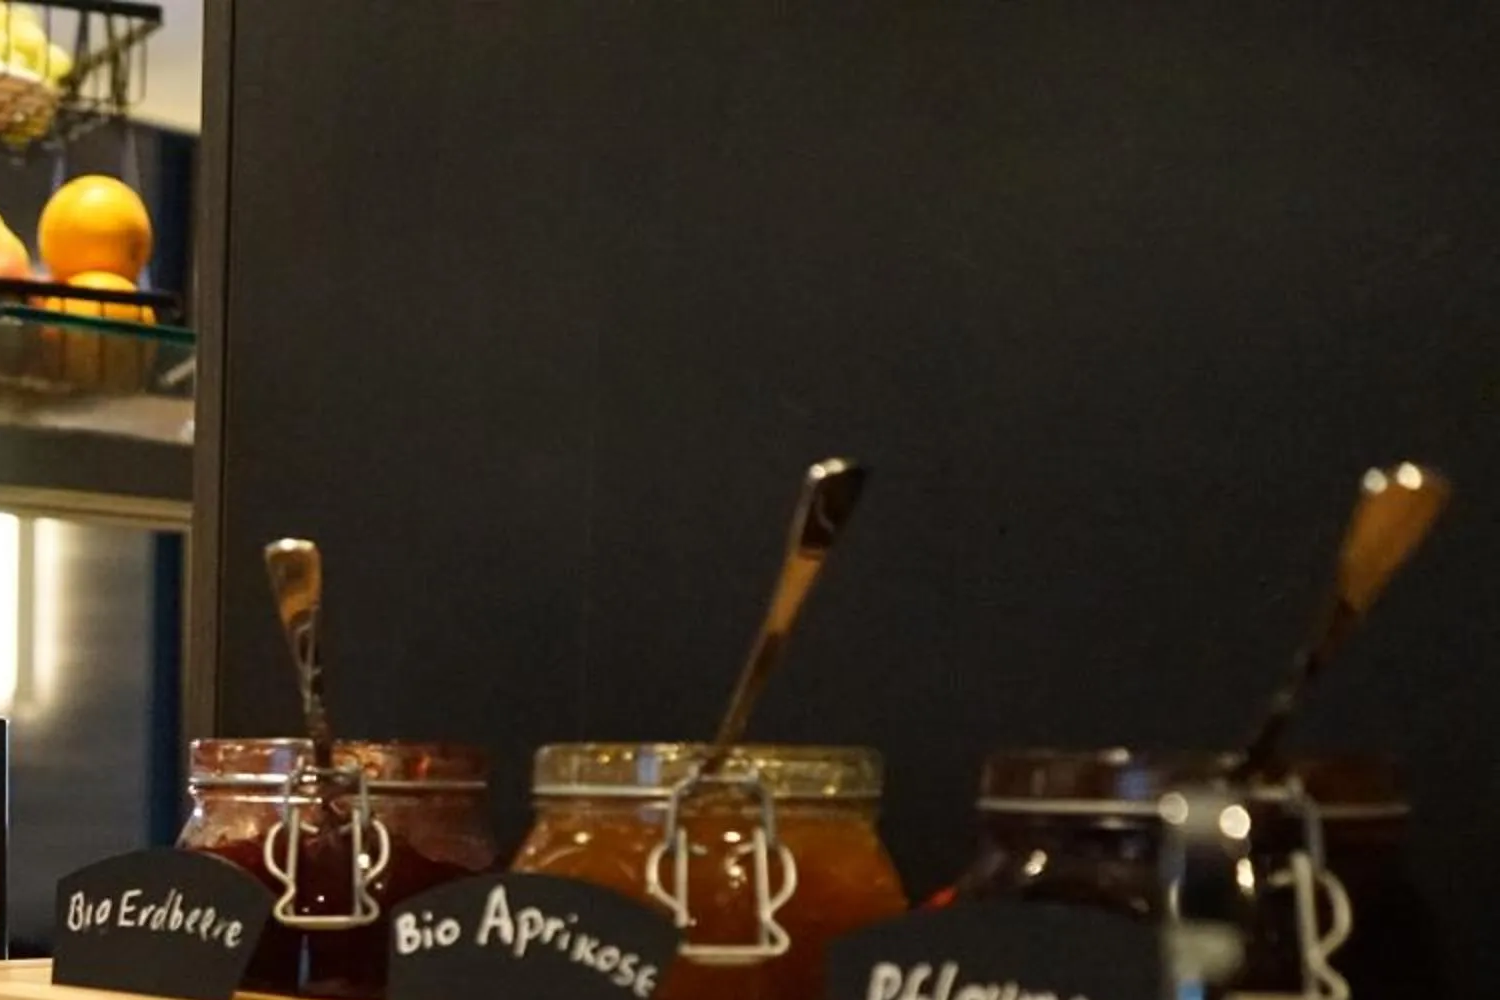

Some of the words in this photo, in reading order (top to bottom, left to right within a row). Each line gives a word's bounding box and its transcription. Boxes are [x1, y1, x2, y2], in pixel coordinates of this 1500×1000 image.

[67, 889, 112, 932] Bio
[117, 887, 243, 948] Erdbeere
[395, 910, 461, 954] Bio
